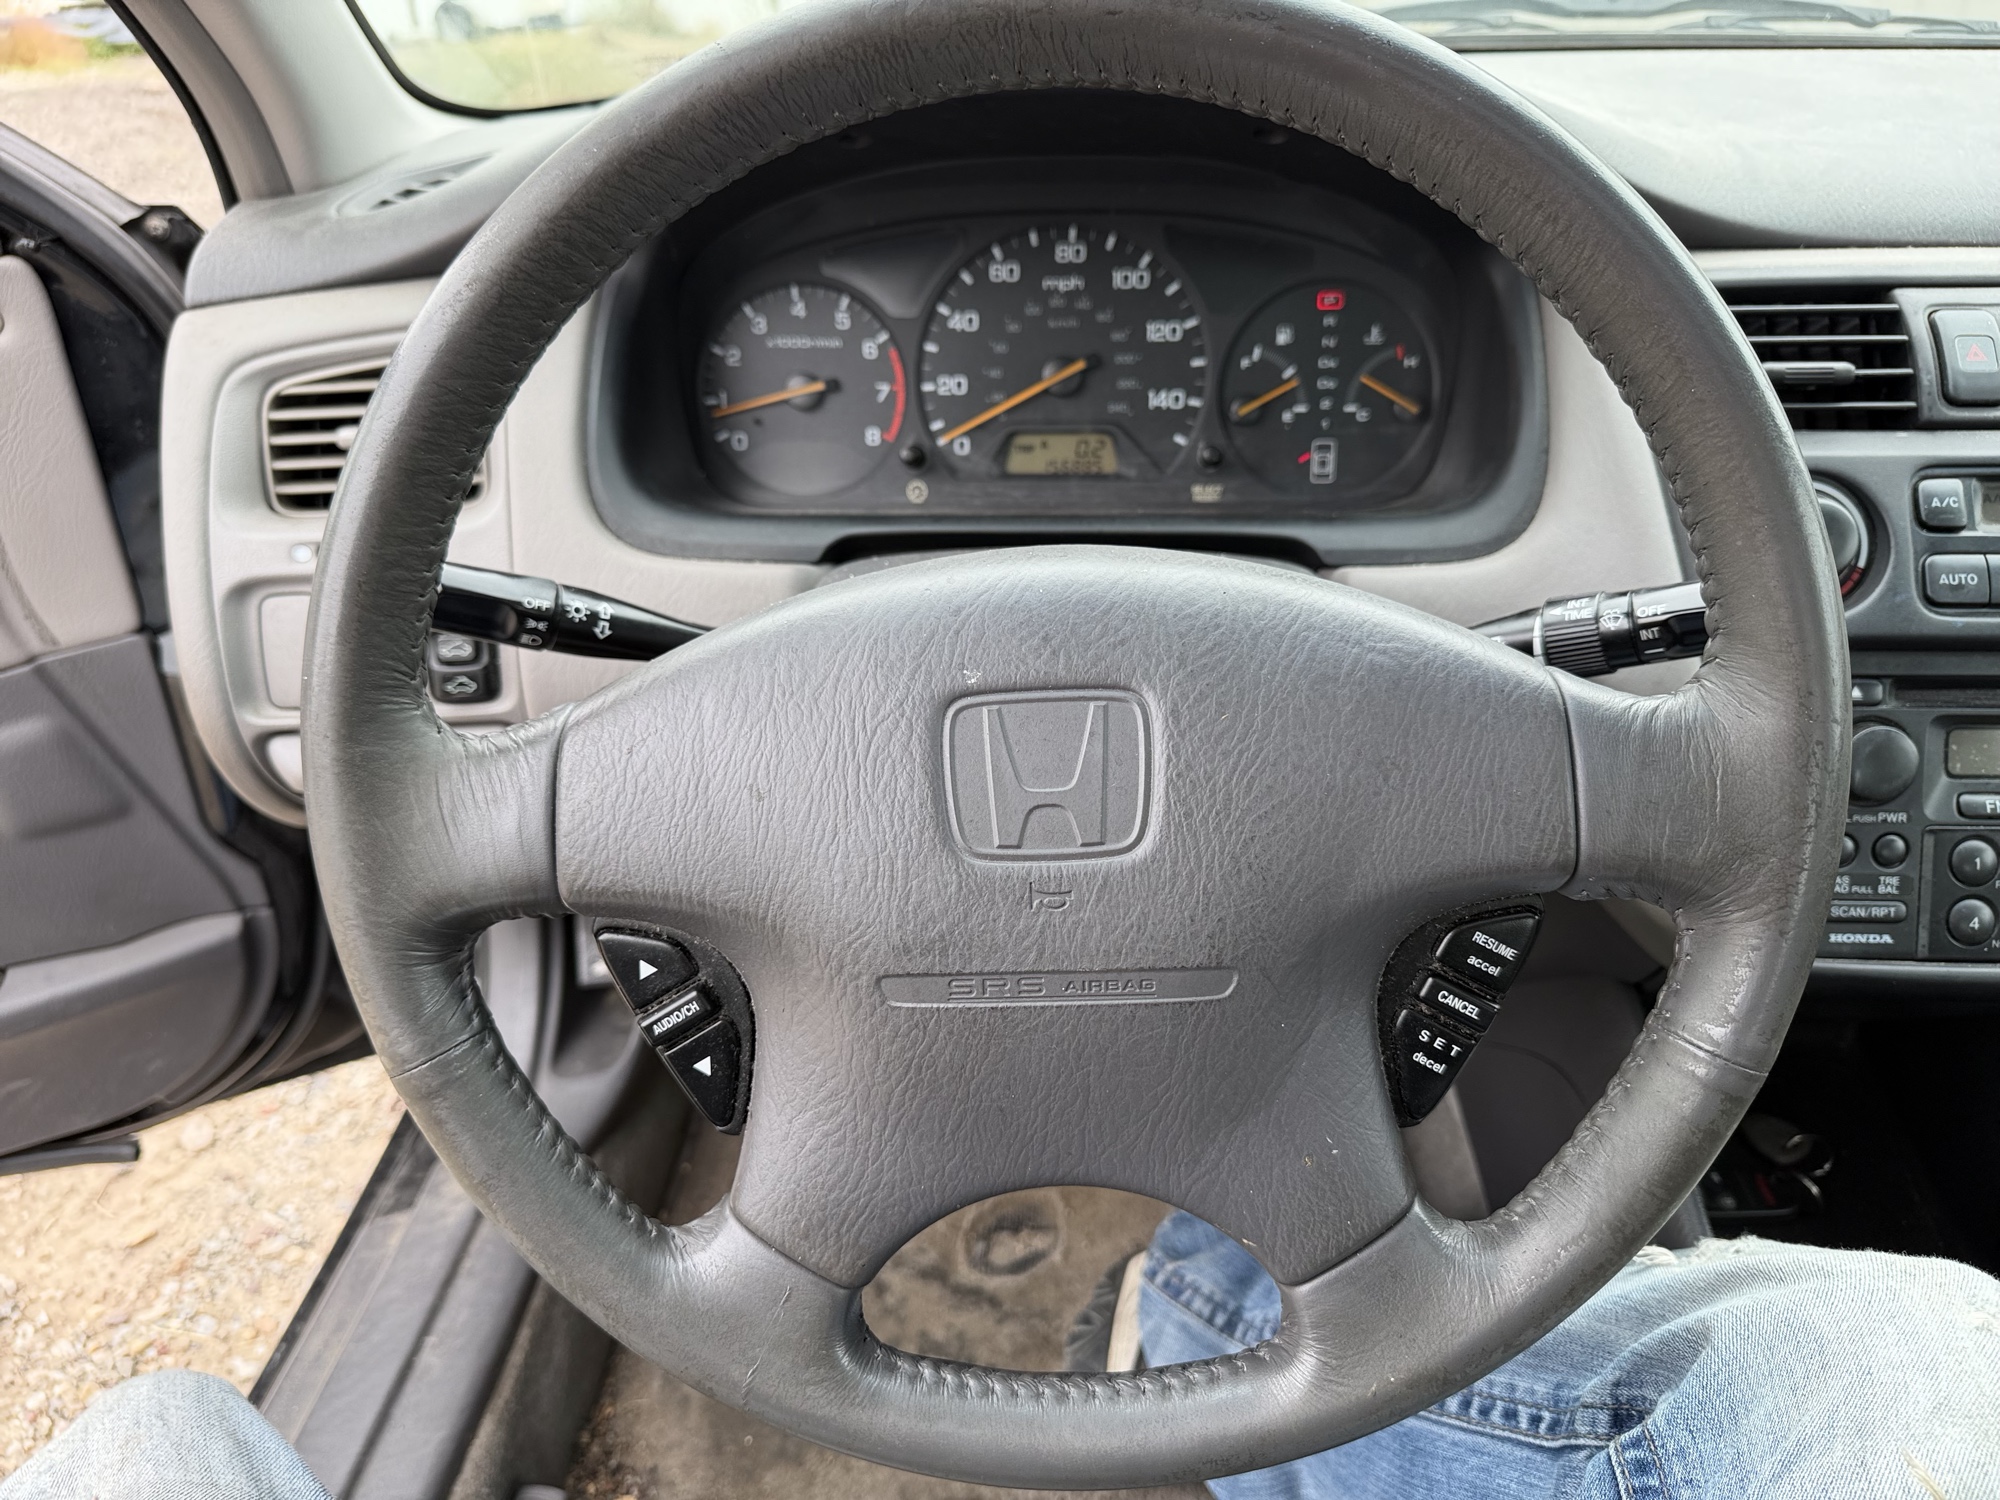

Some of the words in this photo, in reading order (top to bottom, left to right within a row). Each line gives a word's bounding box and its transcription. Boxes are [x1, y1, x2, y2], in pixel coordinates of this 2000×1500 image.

[1054, 242, 1087, 263] 80
[988, 259, 1021, 283] 60
[1112, 267, 1150, 290] 100
[1042, 275, 1085, 292] mph
[789, 299, 807, 319] 4
[751, 314, 768, 336] 3
[834, 311, 851, 331] 5
[947, 309, 980, 332] 40
[1146, 319, 1184, 342] 120
[724, 345, 742, 367] 2
[861, 337, 879, 360] 6
[874, 381, 891, 403] 7
[936, 374, 968, 396] 20
[1148, 388, 1187, 410] 140
[730, 430, 749, 452] 0
[864, 425, 882, 447] 8
[953, 436, 971, 456] 0
[1931, 497, 1959, 508] A/C
[1939, 573, 1978, 586] AUTO
[522, 596, 550, 612] OFF
[1562, 606, 1595, 621] TIME
[1566, 598, 1592, 608] INT
[1636, 603, 1667, 618] OFF
[1639, 626, 1661, 641] INT
[1877, 811, 1908, 823] PWR
[1974, 857, 1982, 871] 1
[1877, 885, 1900, 895] BAL
[1878, 875, 1901, 886] TRE
[1830, 905, 1897, 918] SCAN/RPT
[1967, 916, 1981, 930] 4
[1472, 931, 1521, 961] RESUME
[1828, 932, 1894, 944] HONDA
[1466, 954, 1501, 977] accel
[949, 977, 1046, 999] SRS
[1064, 979, 1157, 993] AIRBAG
[1437, 990, 1481, 1021] CANCEL
[652, 1001, 700, 1036] AUDIO/CH
[1412, 1051, 1447, 1075] decel
